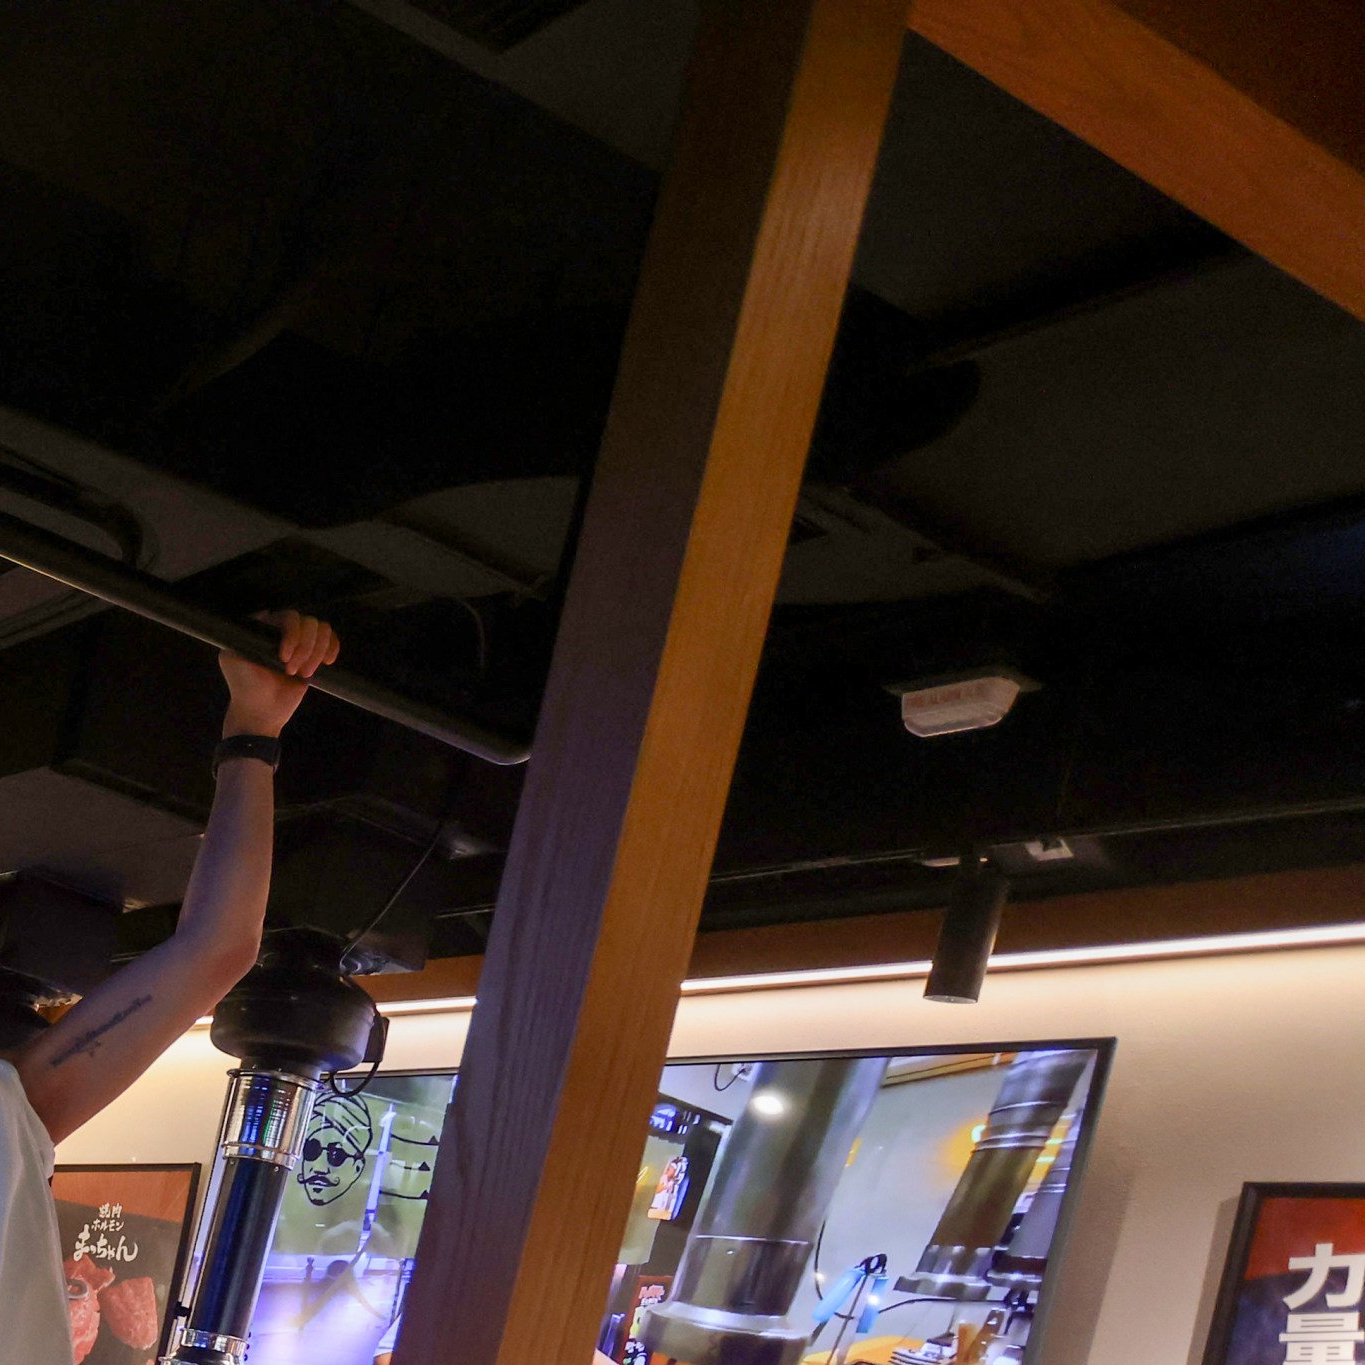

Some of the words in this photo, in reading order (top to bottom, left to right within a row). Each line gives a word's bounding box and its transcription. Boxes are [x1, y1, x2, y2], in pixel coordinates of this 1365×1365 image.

[91, 1218, 125, 1232] ホルモン
[73, 1223, 139, 1262] まっちゃん
